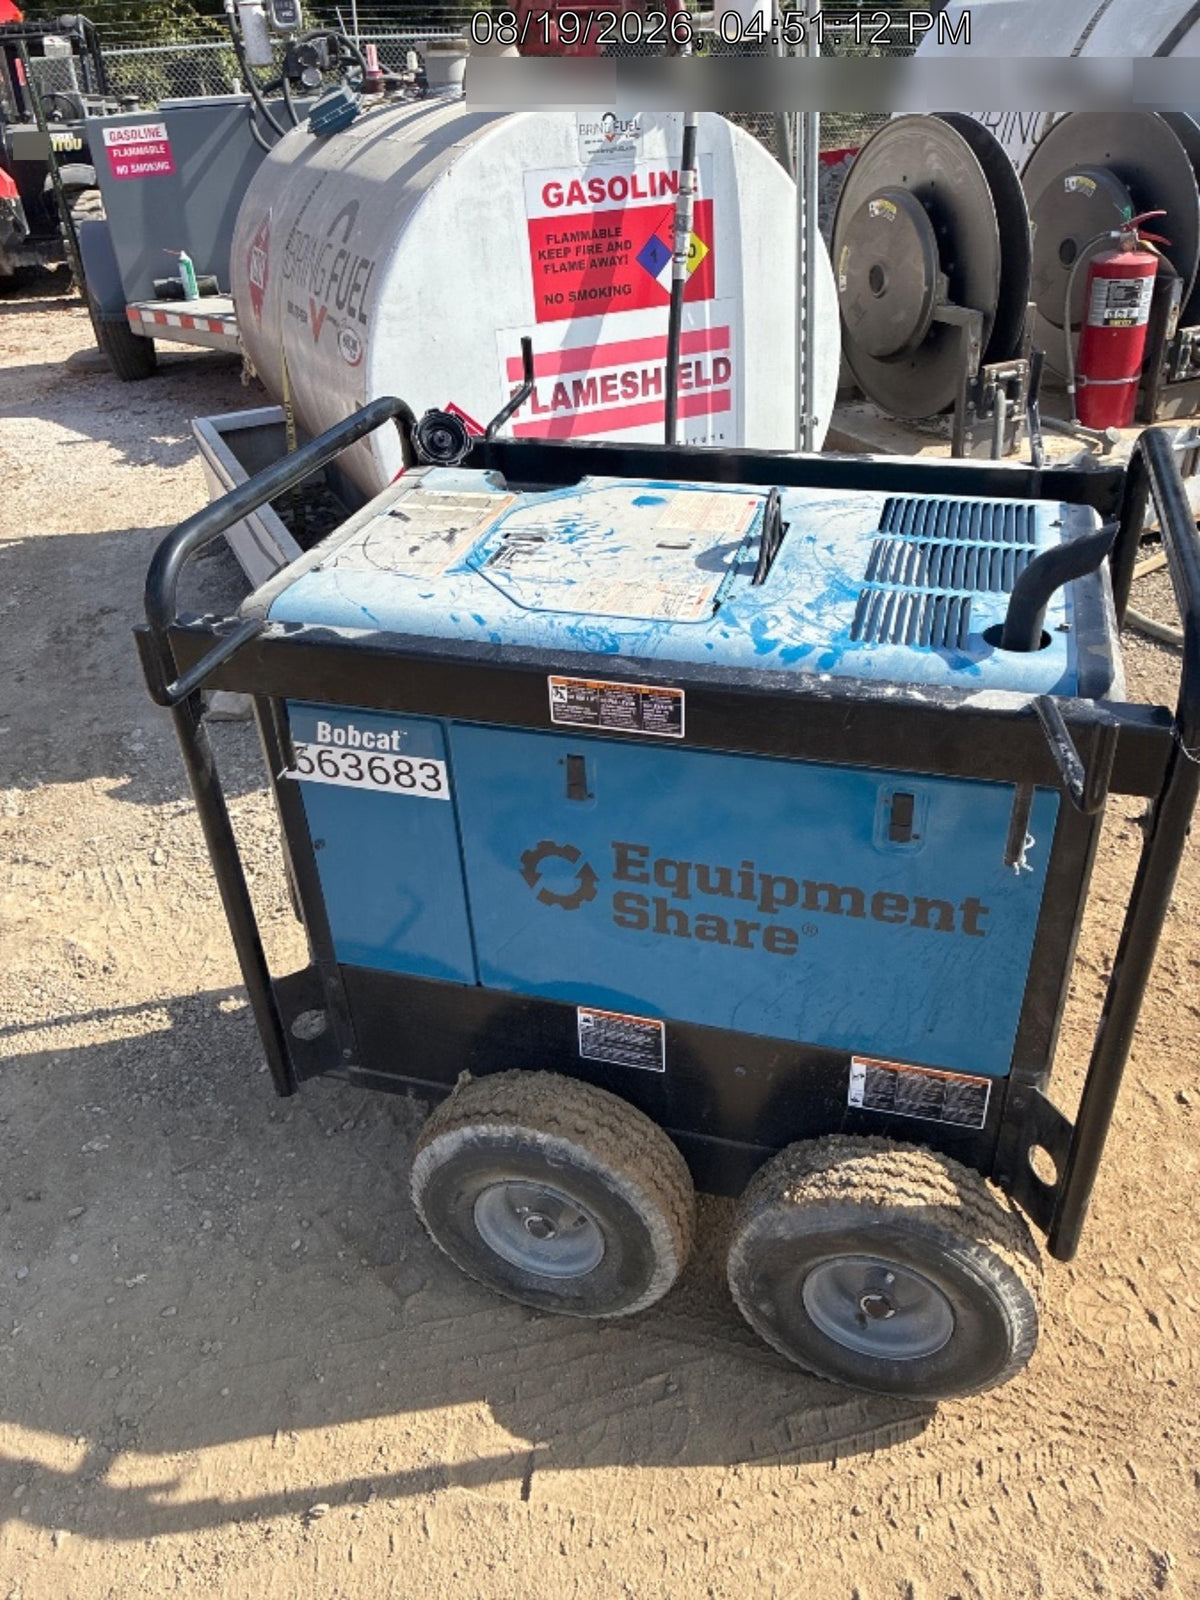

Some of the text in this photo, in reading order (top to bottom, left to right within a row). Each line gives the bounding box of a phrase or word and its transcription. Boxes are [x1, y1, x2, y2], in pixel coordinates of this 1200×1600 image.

[109, 126, 162, 142] GASOLINE
[613, 119, 641, 133] FUEL
[113, 143, 166, 157] FLAMMABLE
[116, 161, 170, 175] NO SMOKING
[541, 168, 698, 208] GASOLIN
[545, 227, 622, 245] FLAMMABLE
[537, 240, 632, 261] KEEP FIRE AND
[543, 254, 629, 274] FLAME AWAY!
[325, 248, 376, 325] FUEL
[544, 284, 632, 306] NO SMOKING
[510, 357, 731, 418] LAMESHELD
[317, 721, 400, 751] Bobcat
[611, 841, 989, 937] Equipment
